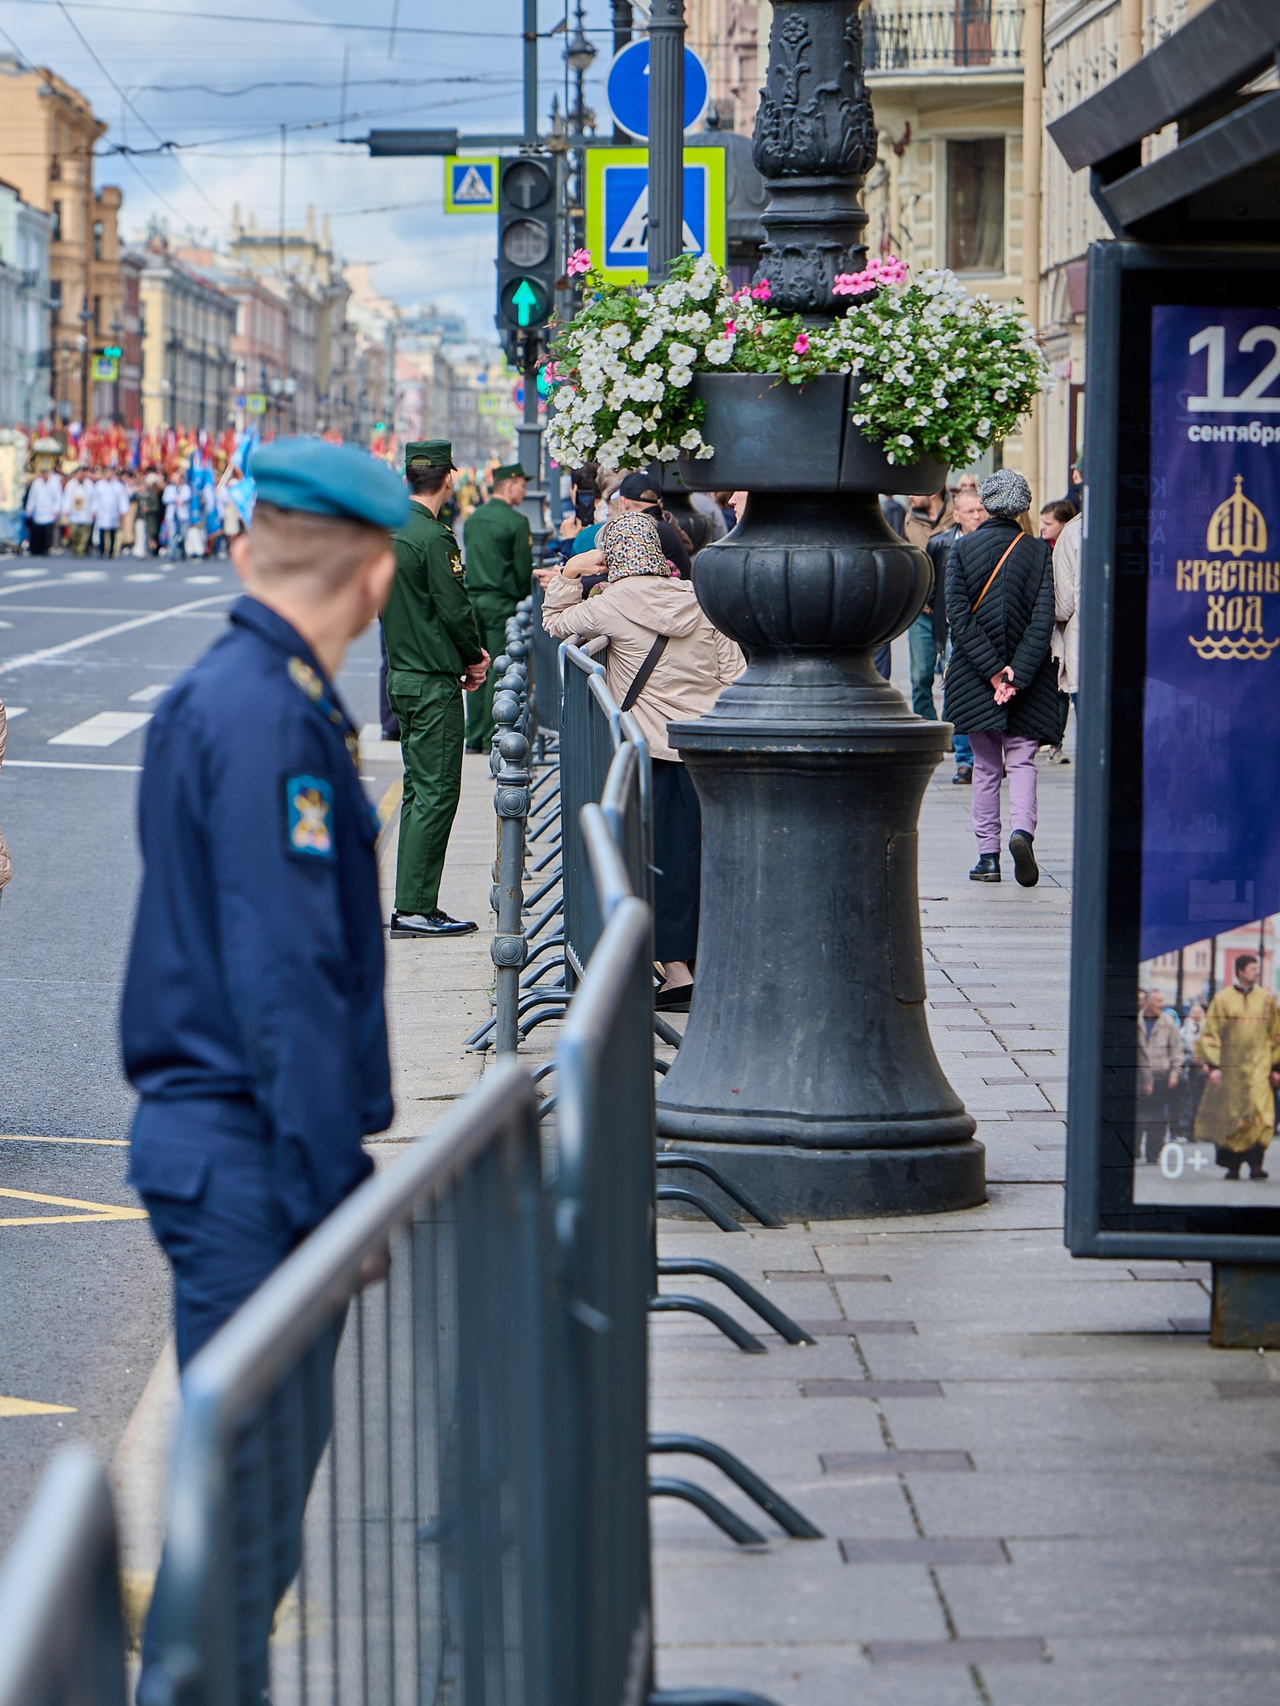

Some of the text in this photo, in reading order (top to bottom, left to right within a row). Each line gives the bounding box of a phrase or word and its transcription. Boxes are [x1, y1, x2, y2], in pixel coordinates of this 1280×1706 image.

[1187, 325, 1280, 413] 12
[1206, 594, 1264, 635] ХОД
[1160, 1142, 1209, 1180] 0+
